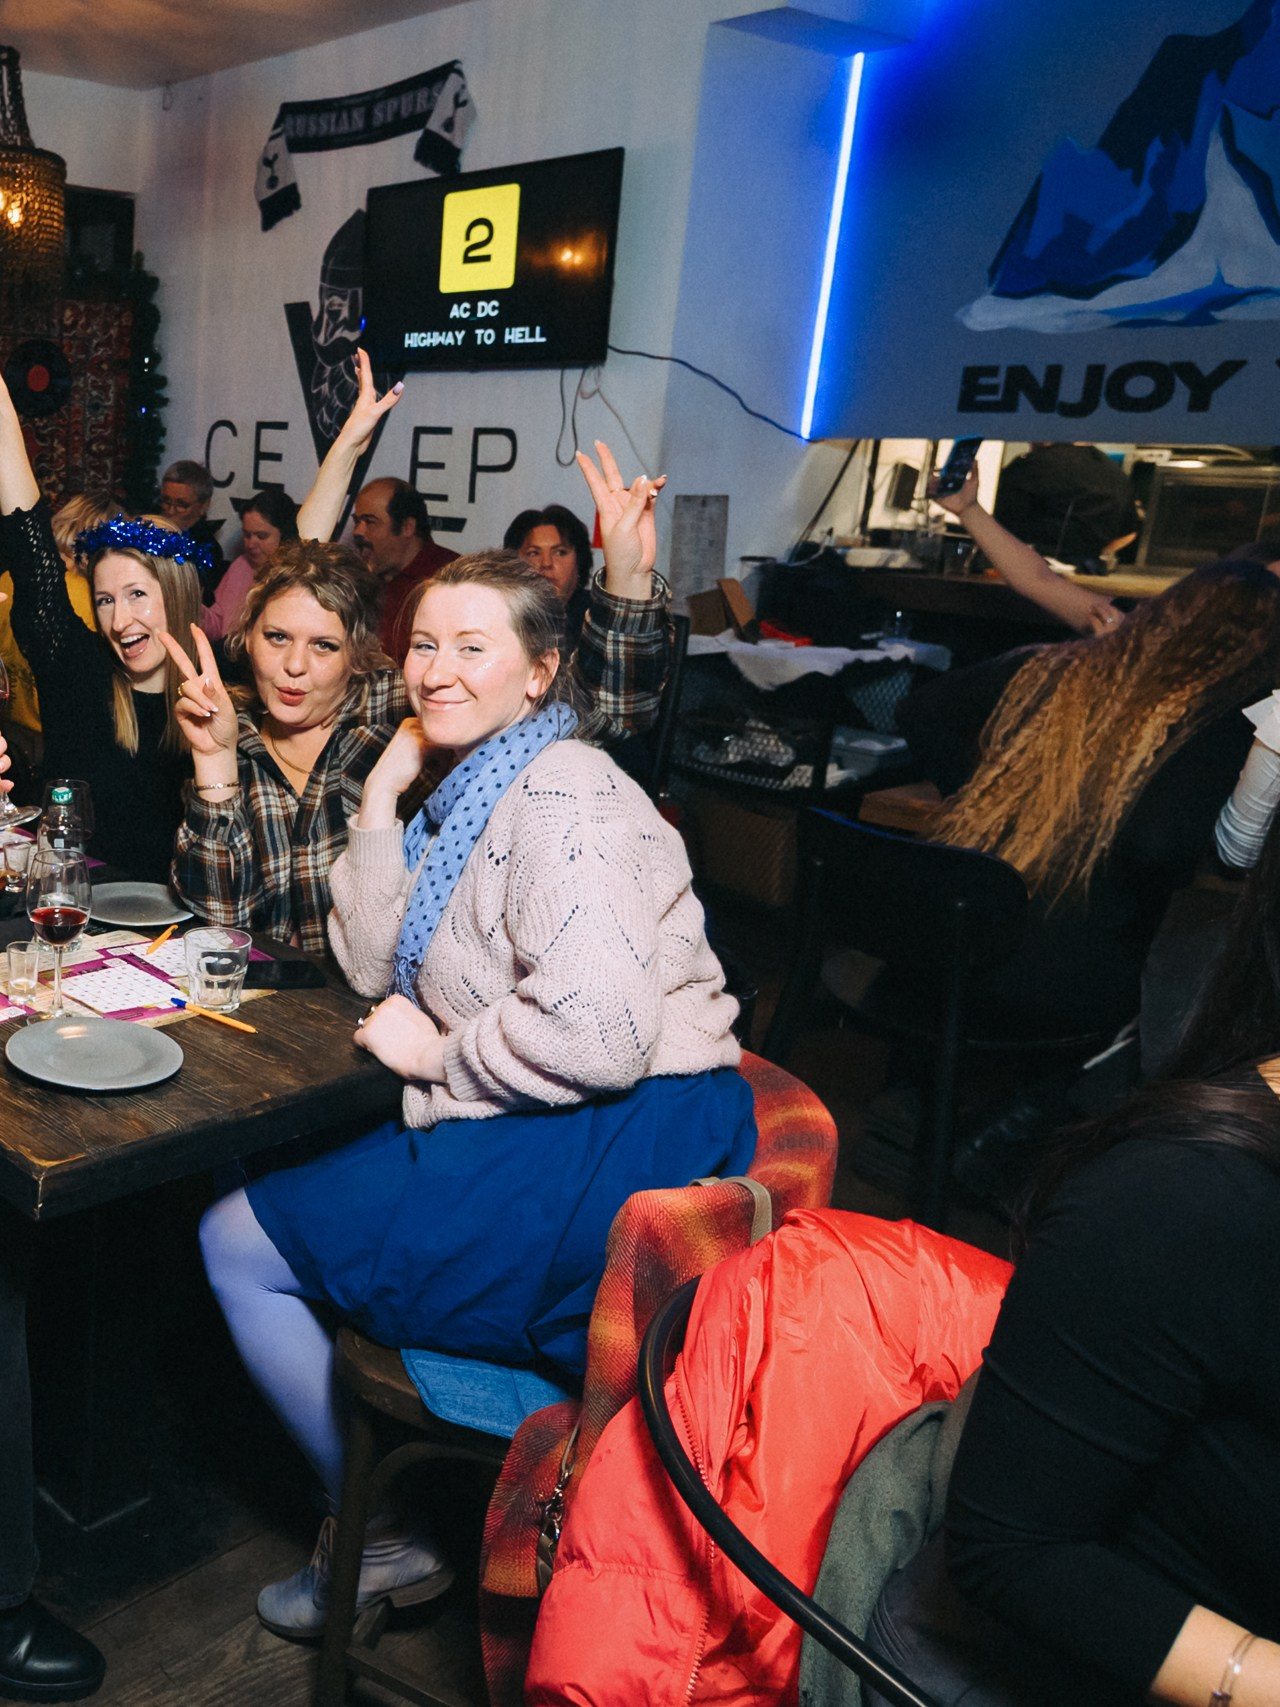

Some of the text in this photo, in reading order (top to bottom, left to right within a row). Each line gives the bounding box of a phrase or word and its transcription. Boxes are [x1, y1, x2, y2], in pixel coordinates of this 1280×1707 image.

[462, 217, 494, 264] 2
[404, 326, 547, 348] HIGHWAY TO HELL
[957, 359, 1249, 419] ENJOY
